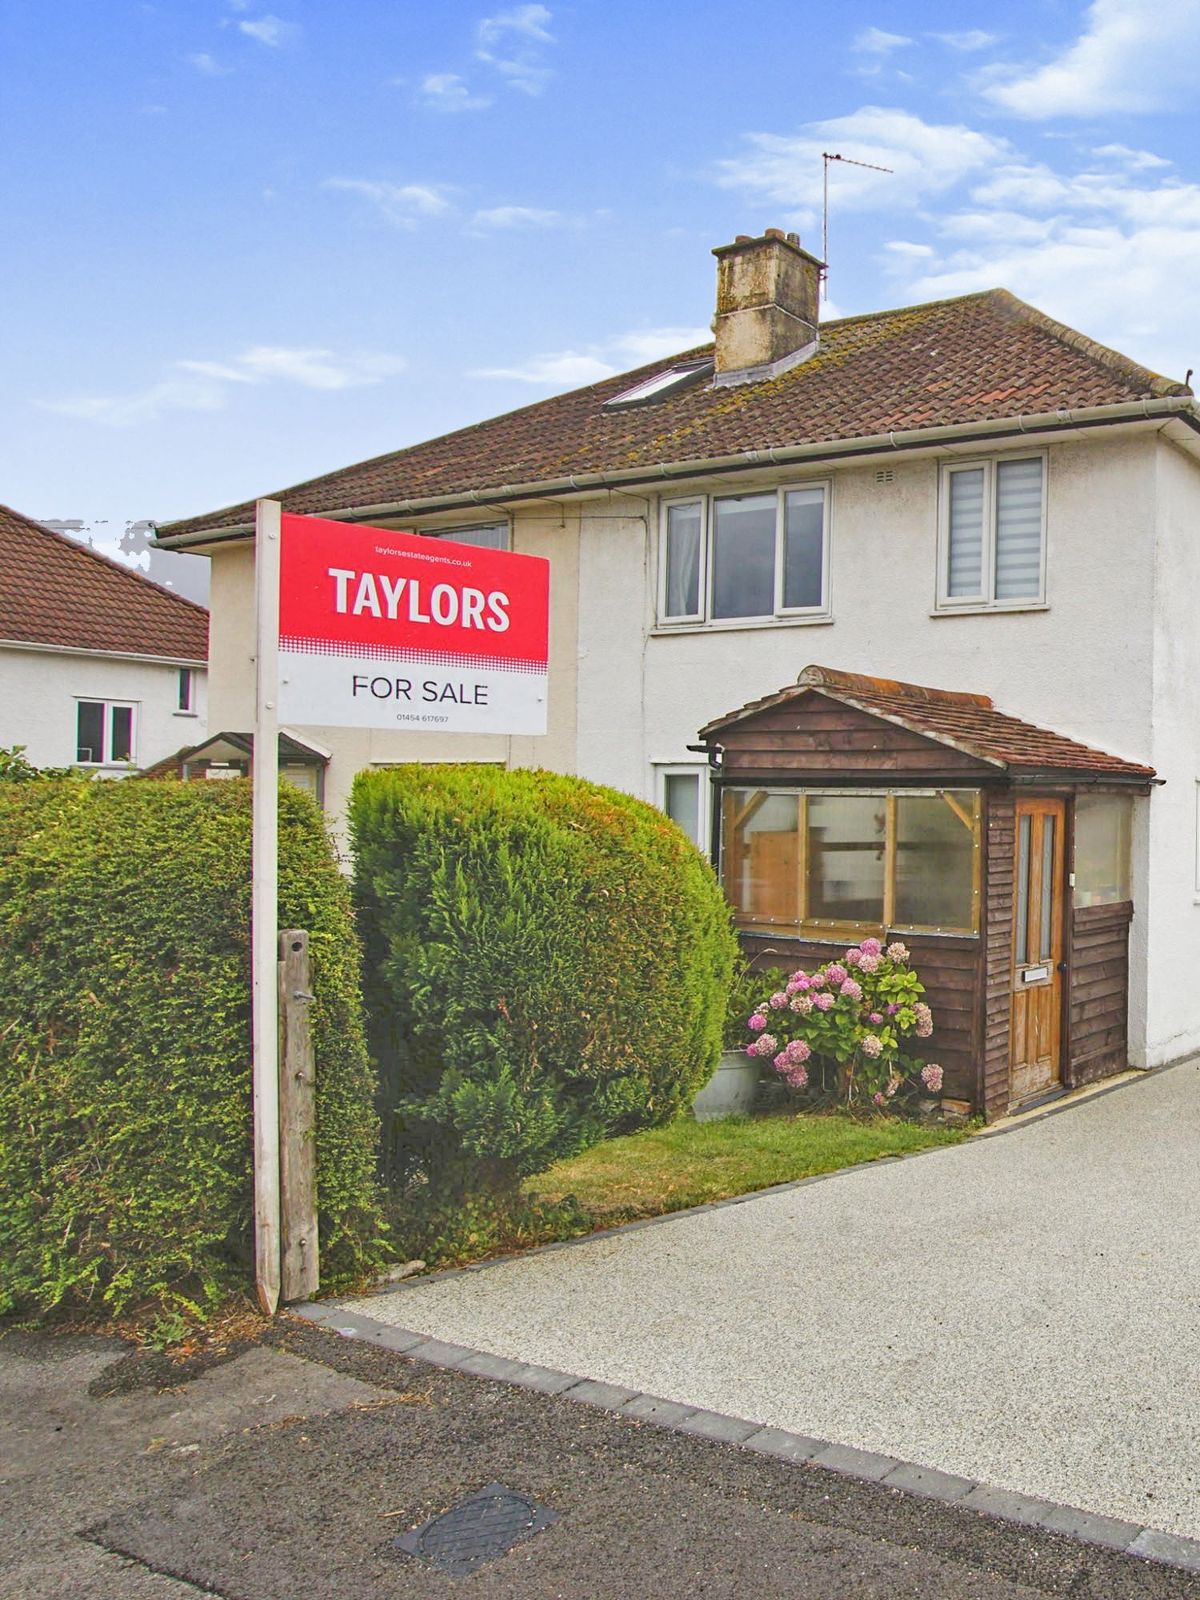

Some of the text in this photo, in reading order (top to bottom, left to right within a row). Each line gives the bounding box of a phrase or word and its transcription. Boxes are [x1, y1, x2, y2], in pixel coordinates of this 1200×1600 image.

[375, 546, 472, 567] taylorsestateagents.co.uk
[328, 568, 510, 632] TAYLORS
[352, 675, 488, 705] FOR SALE
[396, 713, 420, 722] 01454
